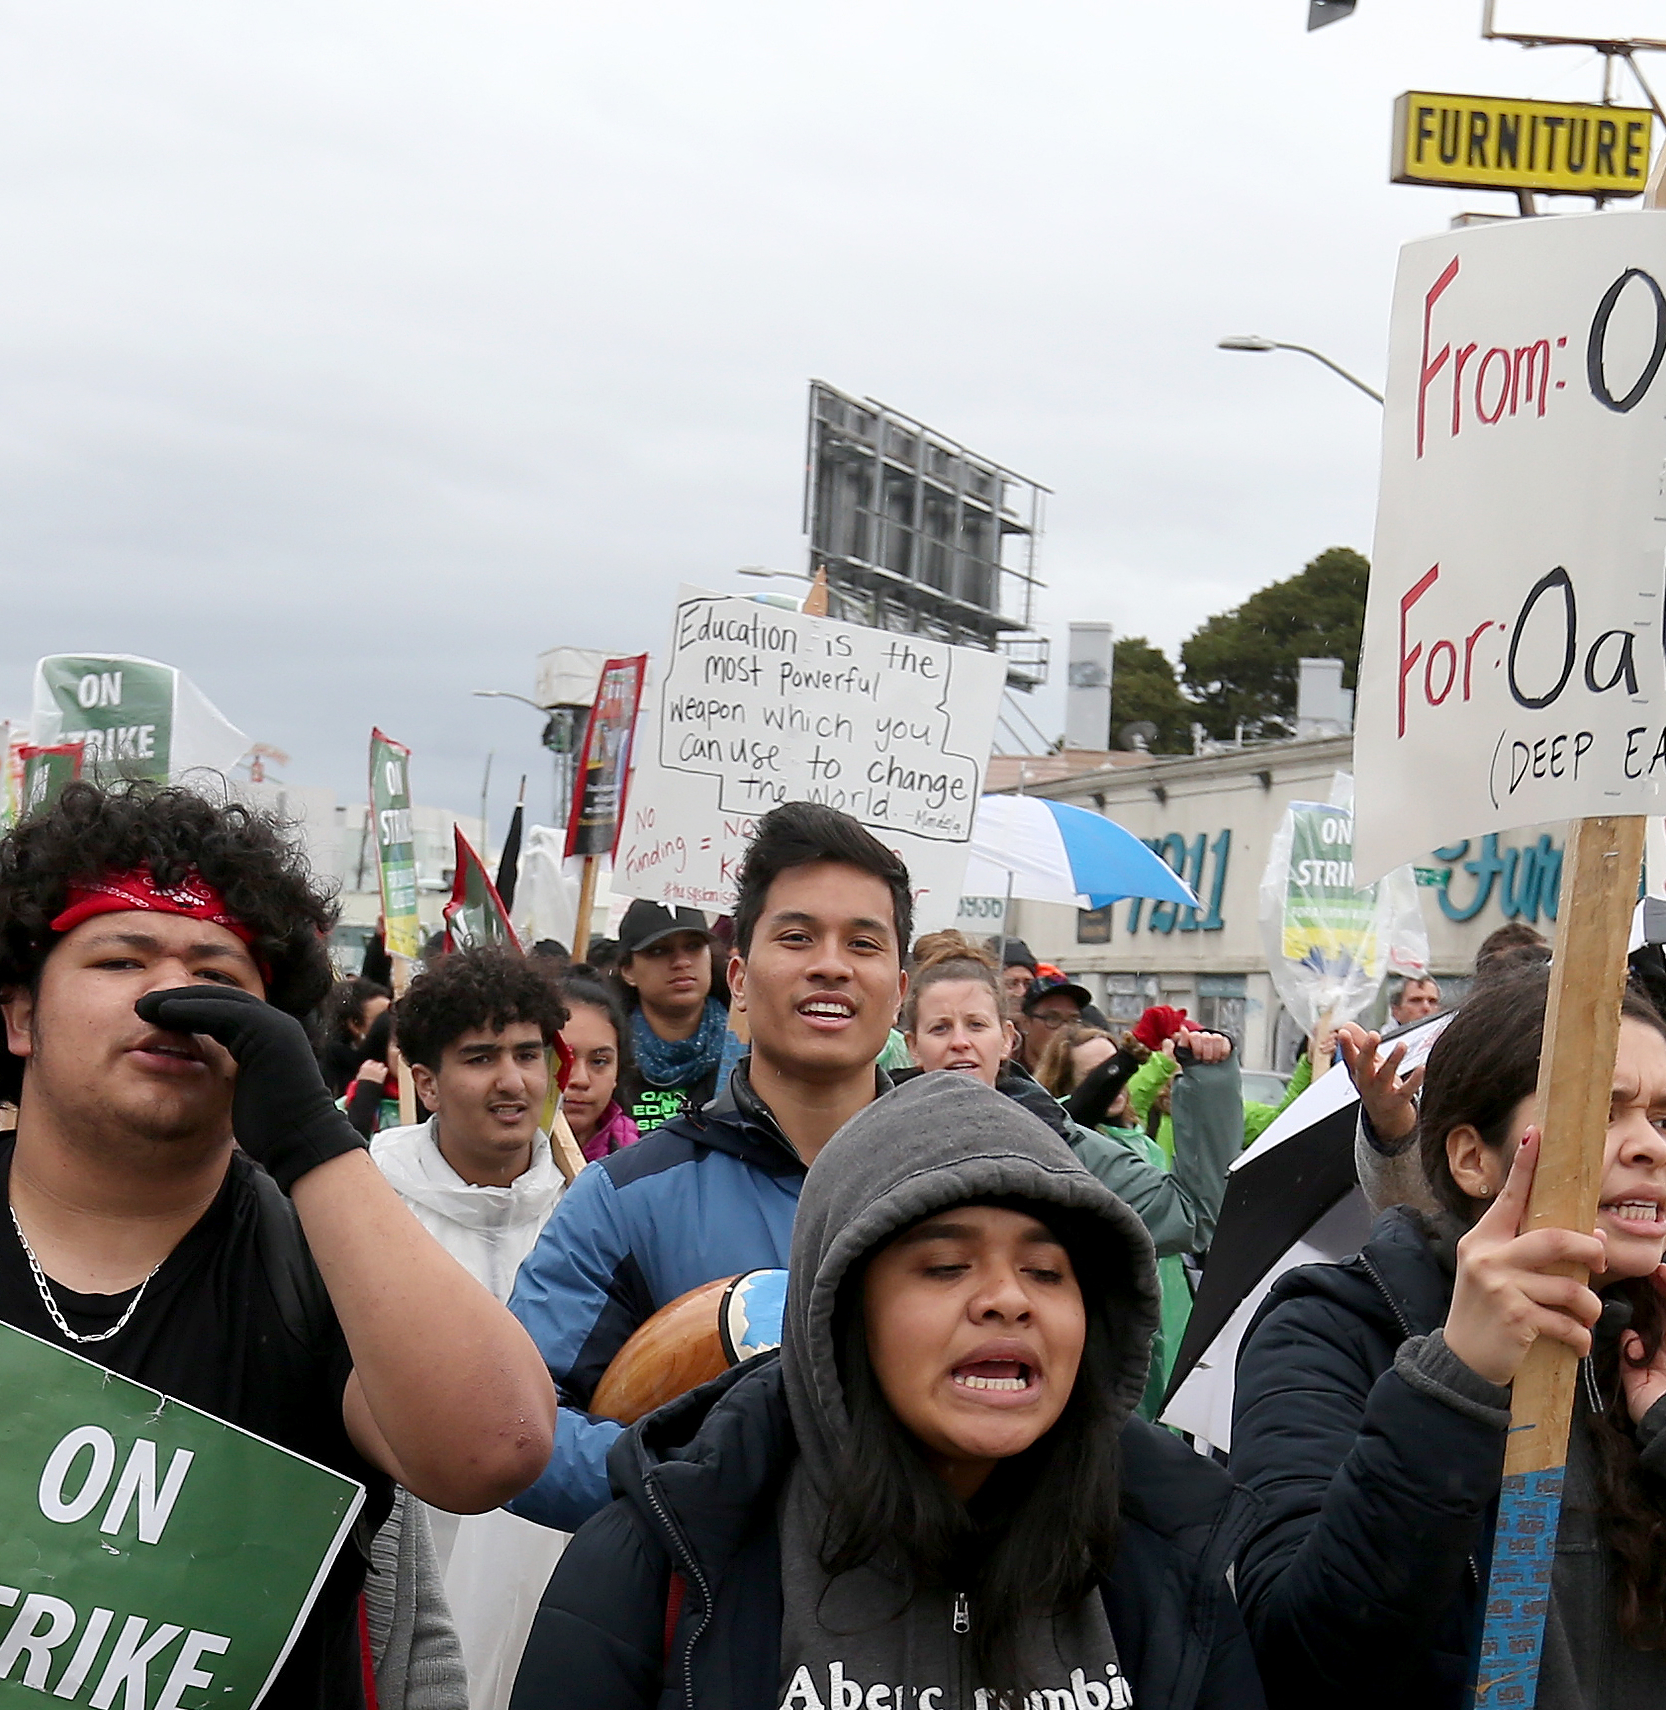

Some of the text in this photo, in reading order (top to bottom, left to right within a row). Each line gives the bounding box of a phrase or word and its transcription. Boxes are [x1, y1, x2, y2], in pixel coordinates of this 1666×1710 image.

[1416, 107, 1643, 177] FURNITURE
[1417, 255, 1566, 459] From:
[679, 604, 940, 679] Education is the
[1397, 562, 1505, 739] For:
[78, 671, 123, 709] ON
[762, 707, 853, 742] which
[875, 716, 932, 752] you
[731, 740, 780, 771] use
[807, 746, 841, 780] to
[867, 756, 968, 809] change
[738, 774, 788, 804] the
[1489, 729, 1593, 809] (DEEP
[37, 1425, 195, 1544] ON
